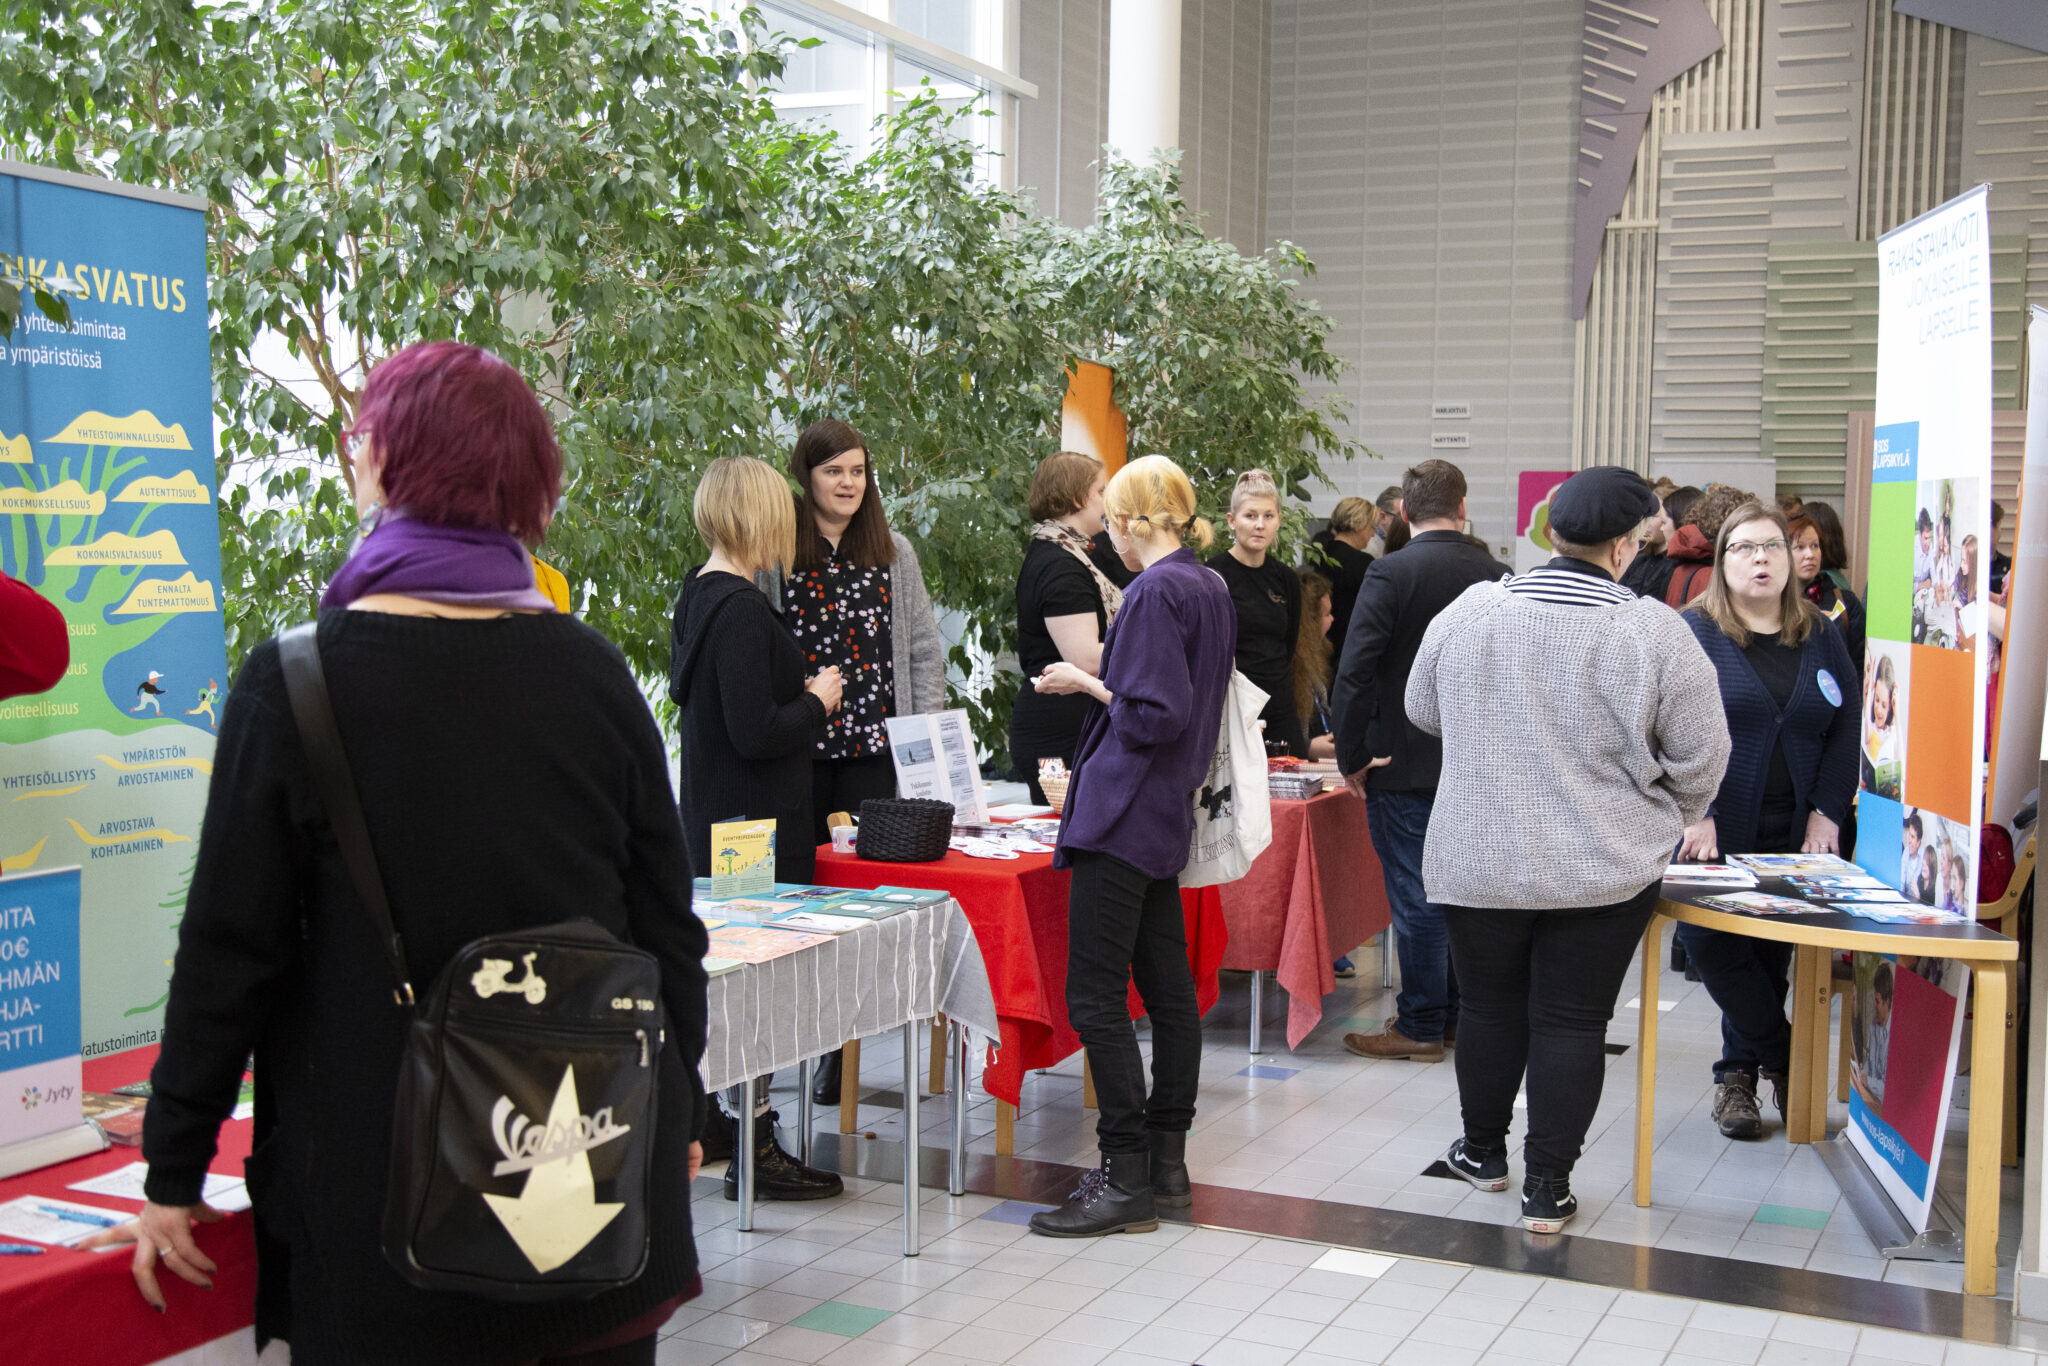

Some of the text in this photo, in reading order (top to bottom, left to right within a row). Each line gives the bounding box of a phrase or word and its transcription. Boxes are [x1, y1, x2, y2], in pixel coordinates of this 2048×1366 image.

[1951, 209, 1979, 250] KOTI
[1919, 298, 1979, 345] LAPSELLE
[10, 345, 102, 369] ympäristöissä
[77, 428, 175, 443] YHTEISTOIMINNALLISUUS
[139, 487, 197, 498] AUTENTTISUUS
[2, 499, 91, 510] KOKEMUKSELLISUUS
[76, 550, 163, 560] KOKONAISVALTAISUUS
[157, 585, 191, 594] ENNALTA
[137, 597, 210, 608] TUNTEMATTOMUUS
[67, 621, 97, 636] isuus
[67, 663, 88, 675] uus
[123, 746, 187, 763] YMPÄRISTÖN
[3, 768, 96, 789] YHTEISÖLLISYYS
[118, 768, 194, 787] ARVOSTAMINEN
[99, 816, 156, 835] ARVOSTAVA
[91, 838, 164, 859] KOHTAAMINEN
[0, 905, 36, 930] ITA
[491, 1095, 625, 1170] Vespa
